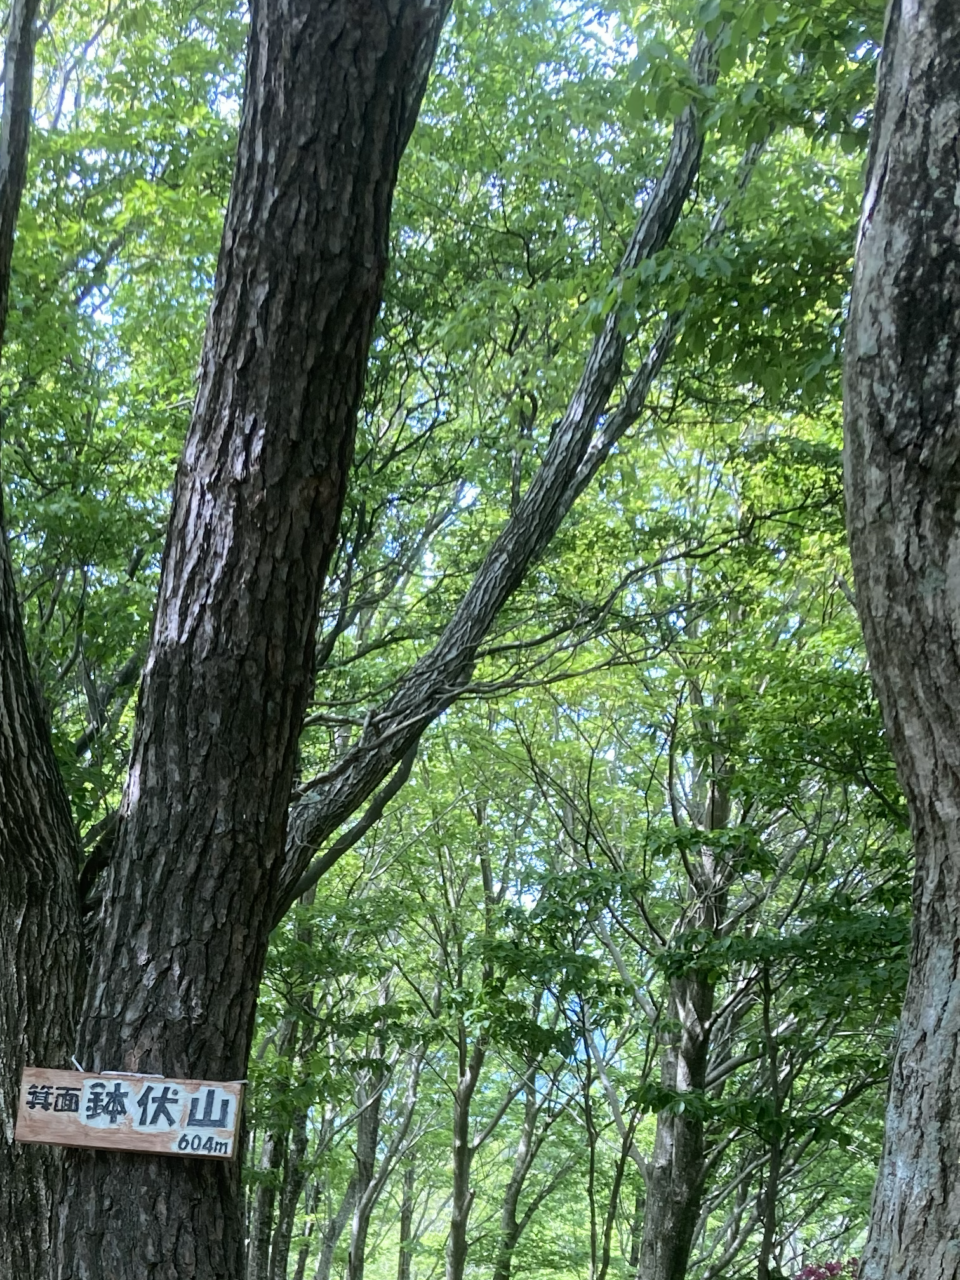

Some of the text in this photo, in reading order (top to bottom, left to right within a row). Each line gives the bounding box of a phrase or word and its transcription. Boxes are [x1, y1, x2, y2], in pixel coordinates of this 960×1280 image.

[26, 1082, 230, 1129] 箕面 鉢伏山
[177, 1133, 229, 1155] 604m
